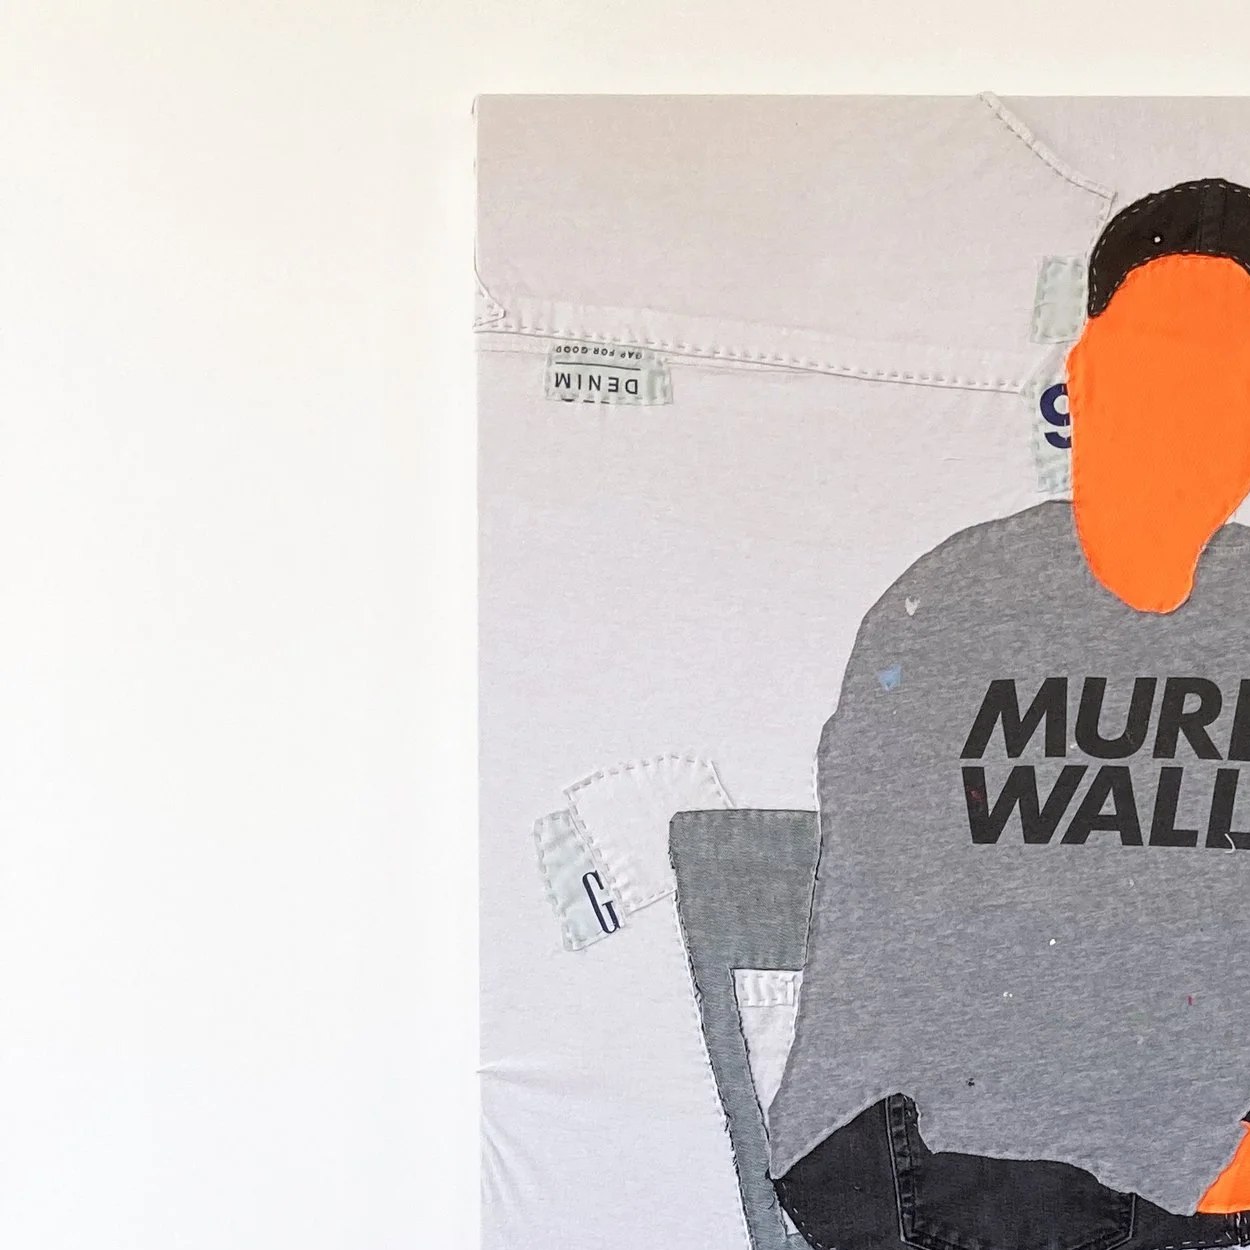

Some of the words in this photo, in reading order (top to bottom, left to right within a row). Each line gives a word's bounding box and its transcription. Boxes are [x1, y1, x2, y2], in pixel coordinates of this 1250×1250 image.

[593, 348, 615, 356] FOR
[555, 372, 638, 394] DENIM
[582, 870, 621, 934] G
